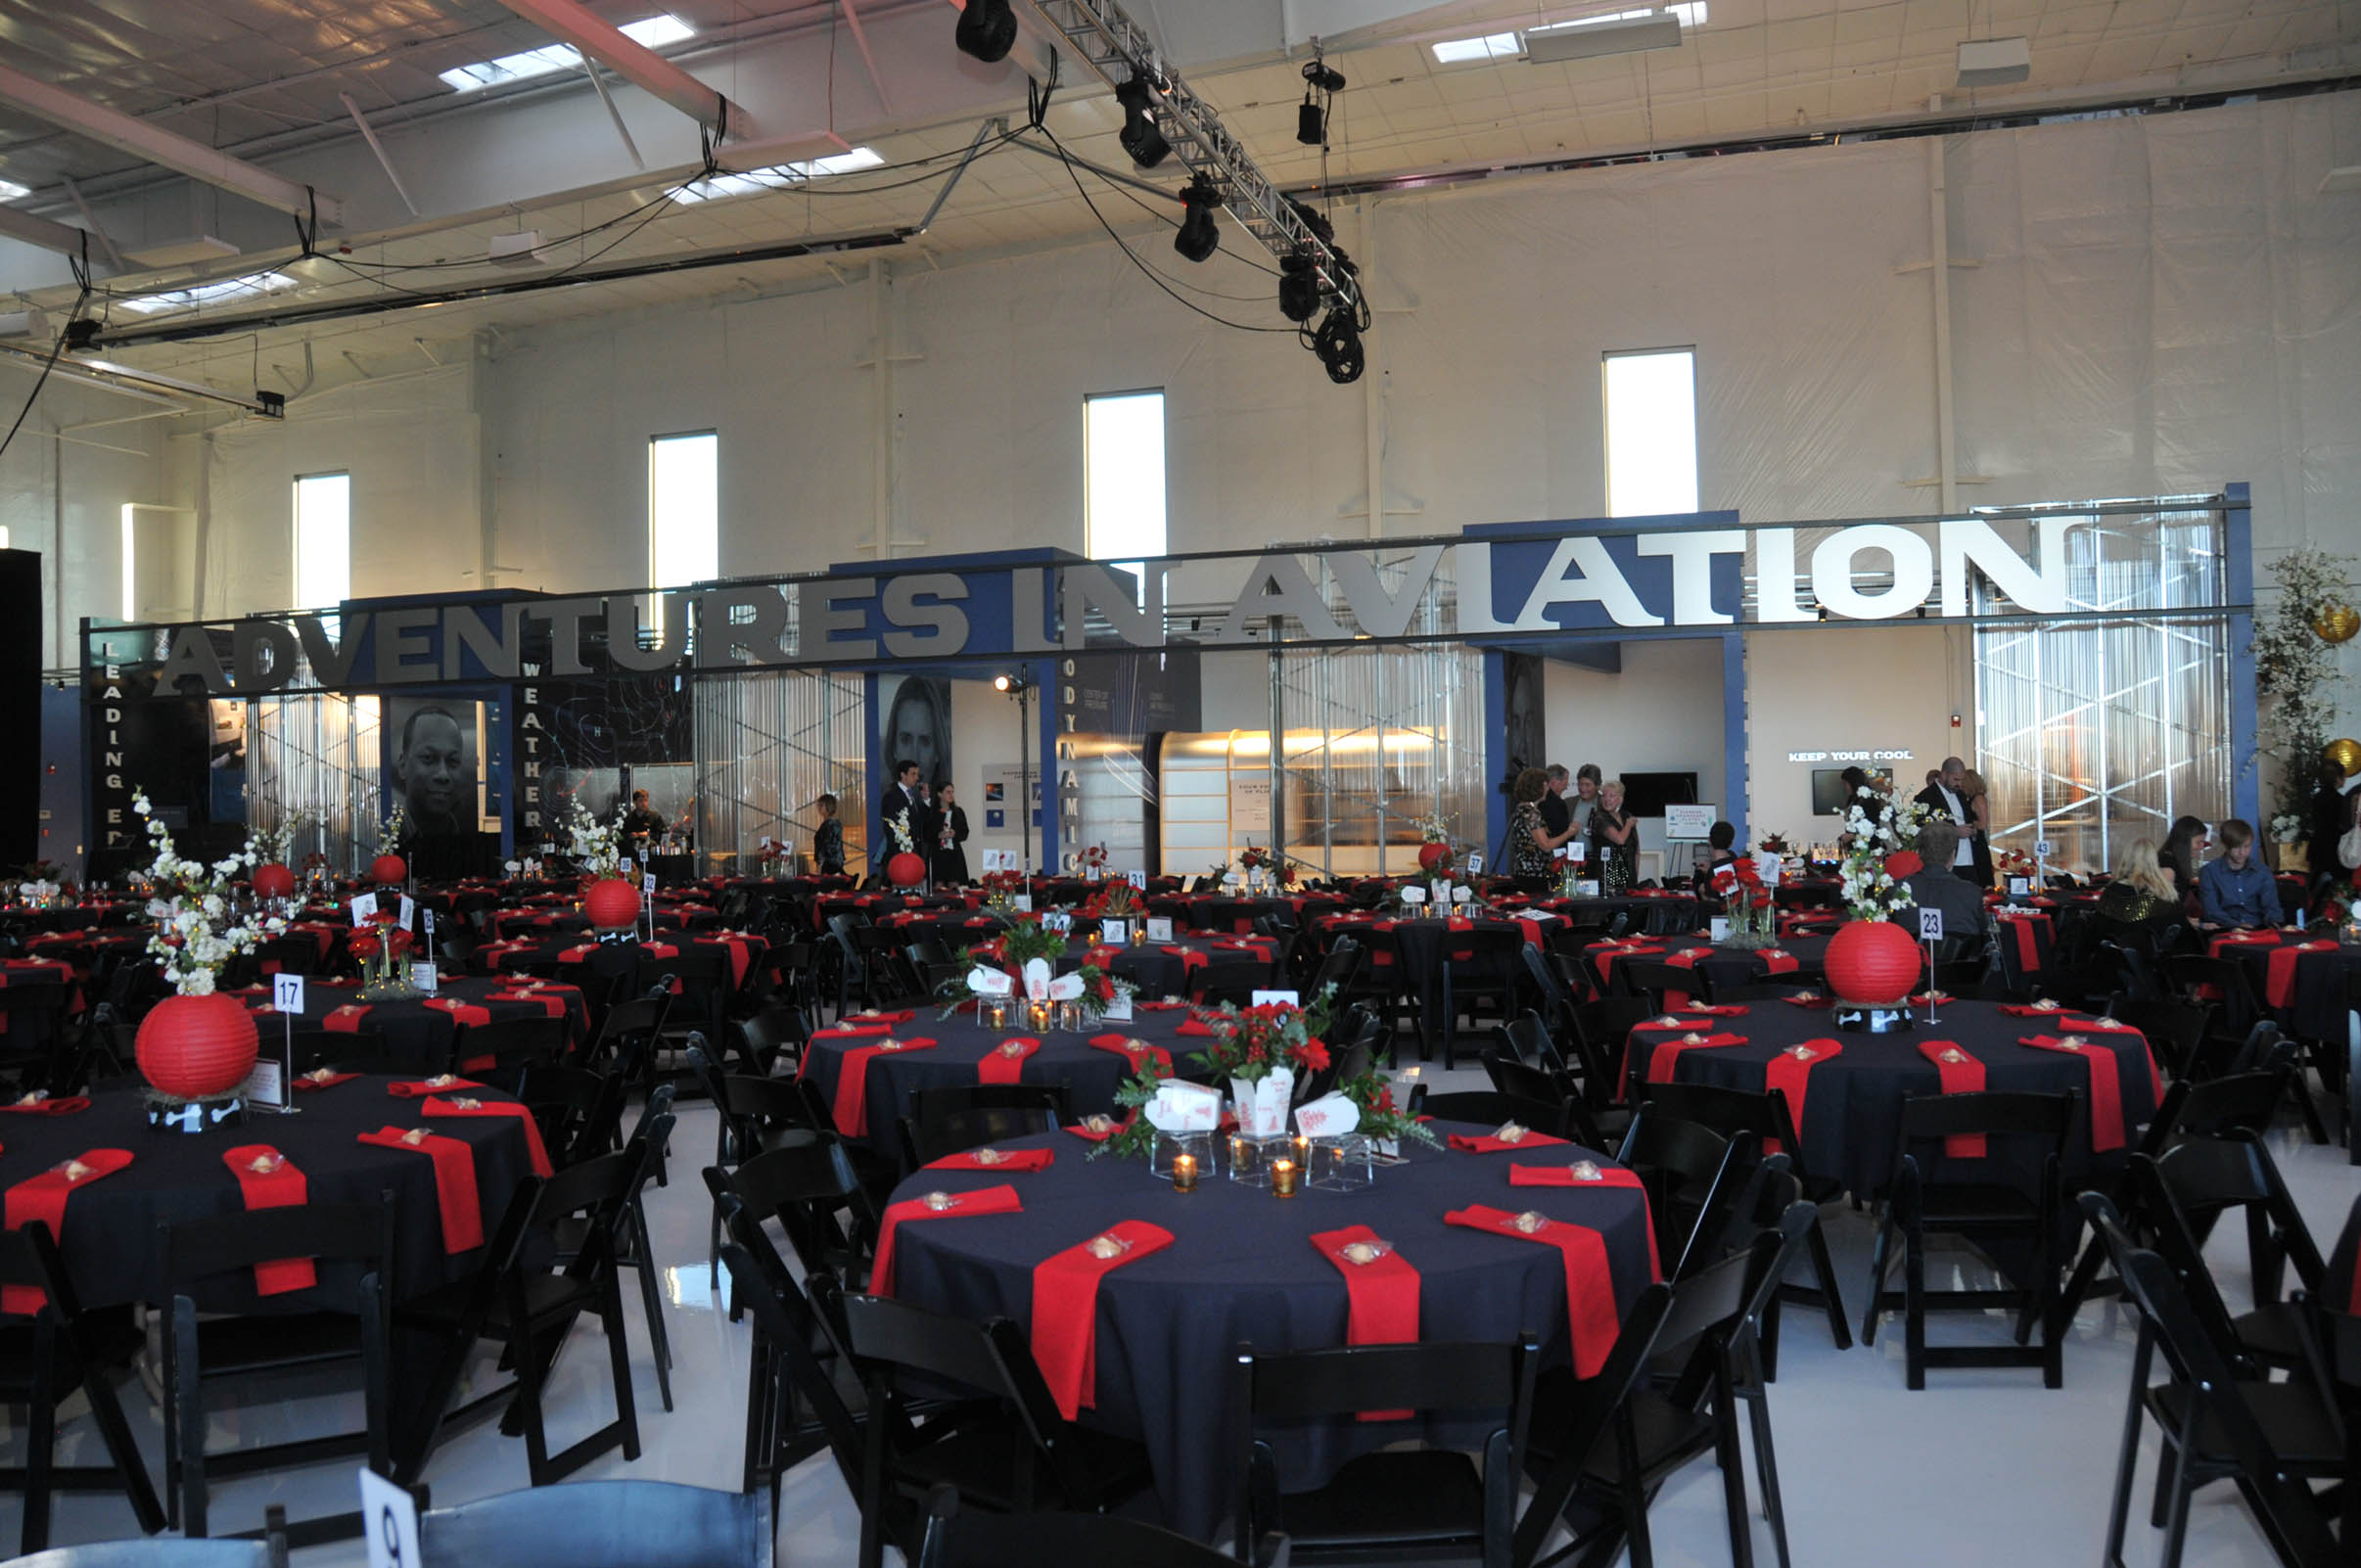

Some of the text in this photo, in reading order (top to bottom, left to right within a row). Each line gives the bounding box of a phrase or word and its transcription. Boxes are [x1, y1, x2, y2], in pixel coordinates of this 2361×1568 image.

[152, 517, 2093, 698] ADVENTURES IN AVIATION
[103, 641, 124, 790] LEADING
[522, 663, 542, 828] WEATHER
[1788, 750, 1915, 761] KEEP YOUR COOL
[1064, 658, 1080, 872] ODYNAMIC
[2037, 843, 2048, 853] 43
[1470, 857, 1481, 870] 37
[645, 876, 654, 890] 32
[1132, 873, 1143, 888] 31
[1923, 913, 1939, 934] 23
[280, 981, 299, 1005] 17
